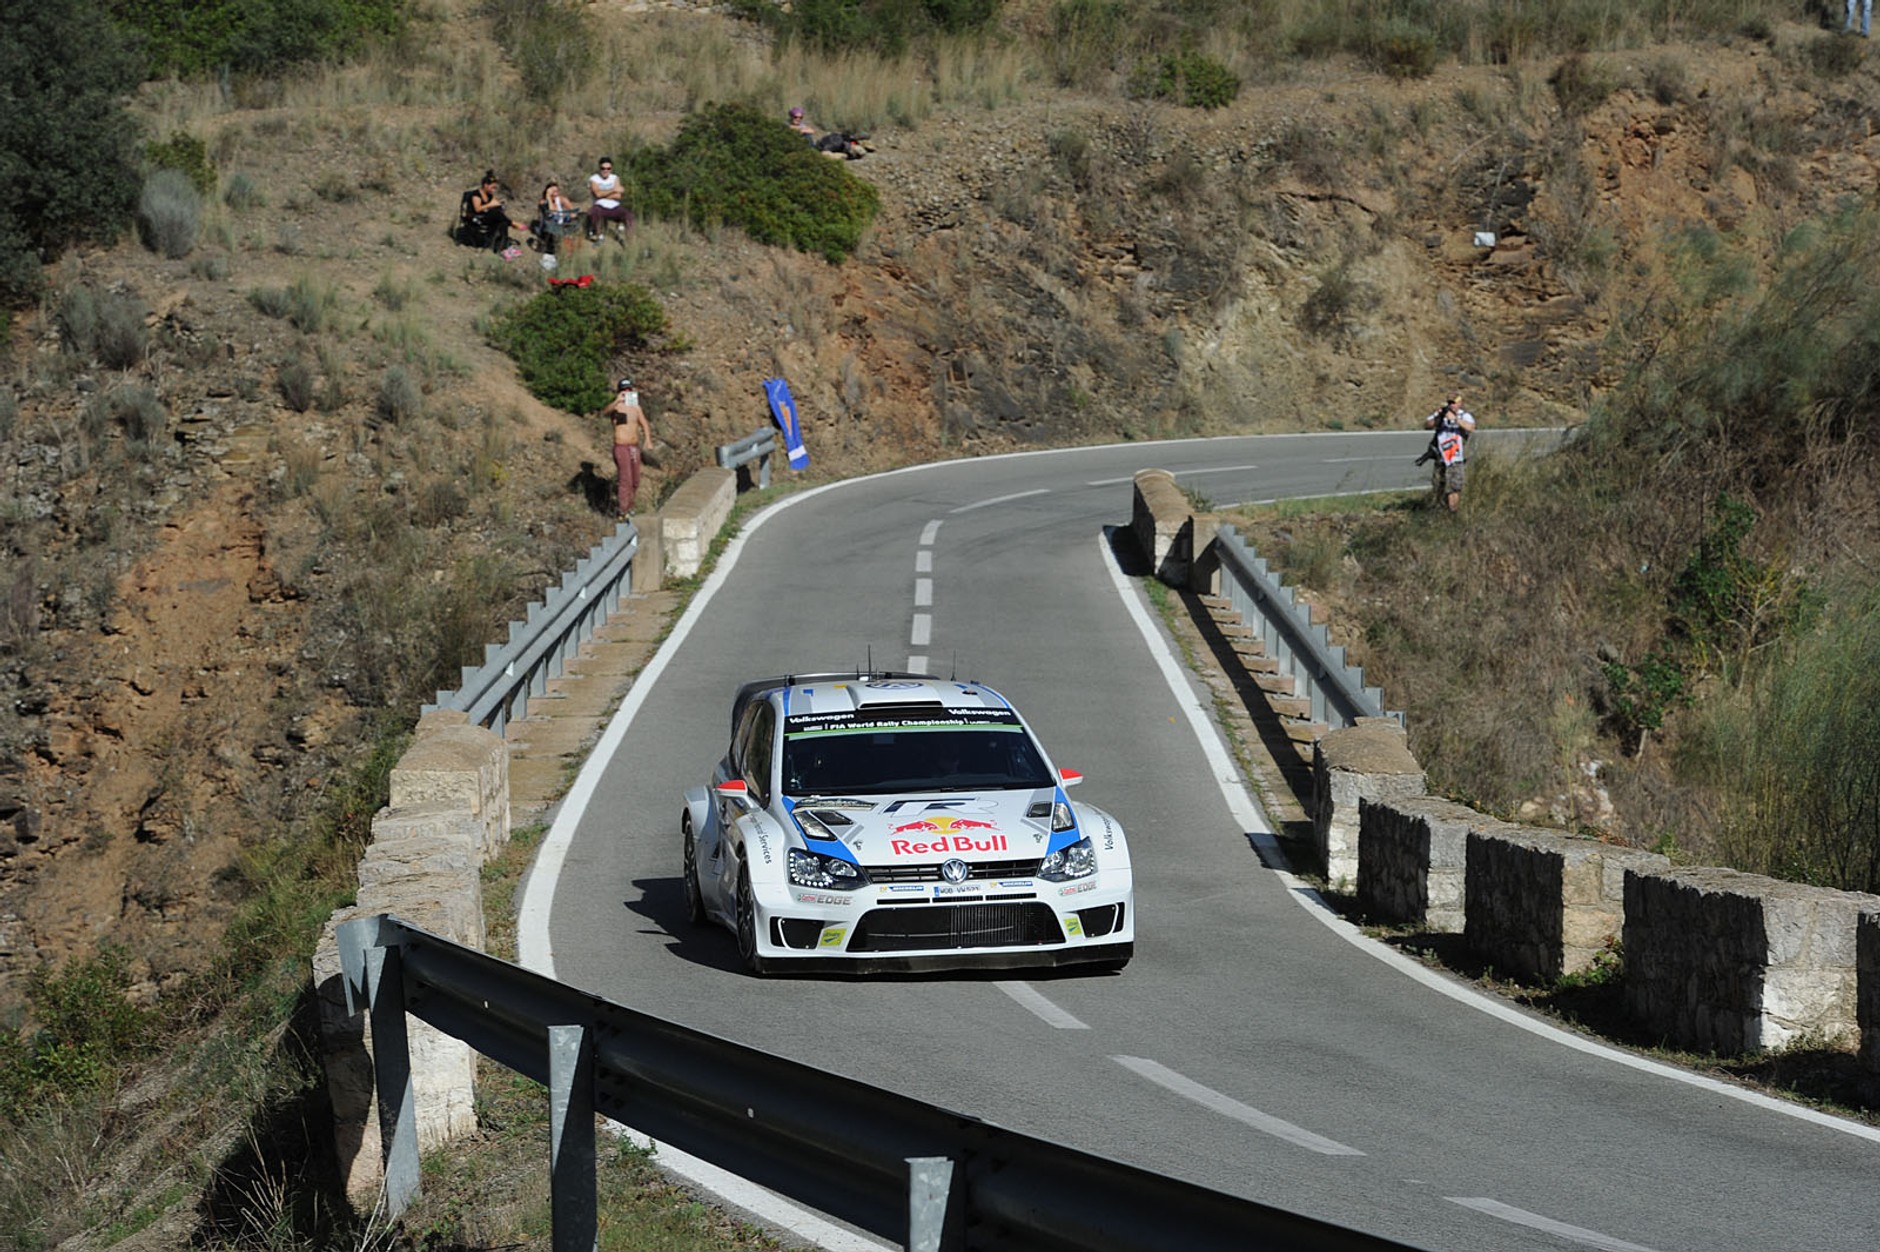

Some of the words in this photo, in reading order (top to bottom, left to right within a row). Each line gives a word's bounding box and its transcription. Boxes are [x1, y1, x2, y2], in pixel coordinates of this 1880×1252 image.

[789, 713, 855, 724] Volkswagen
[948, 708, 1012, 717] Volkswagen
[830, 723, 846, 731] FIA
[847, 721, 875, 729] World
[876, 720, 900, 728] Rally
[901, 719, 964, 727] Championship
[758, 834, 772, 865] Services
[891, 836, 950, 855] Red
[953, 834, 1008, 852] Bull
[817, 894, 853, 906] EDGE
